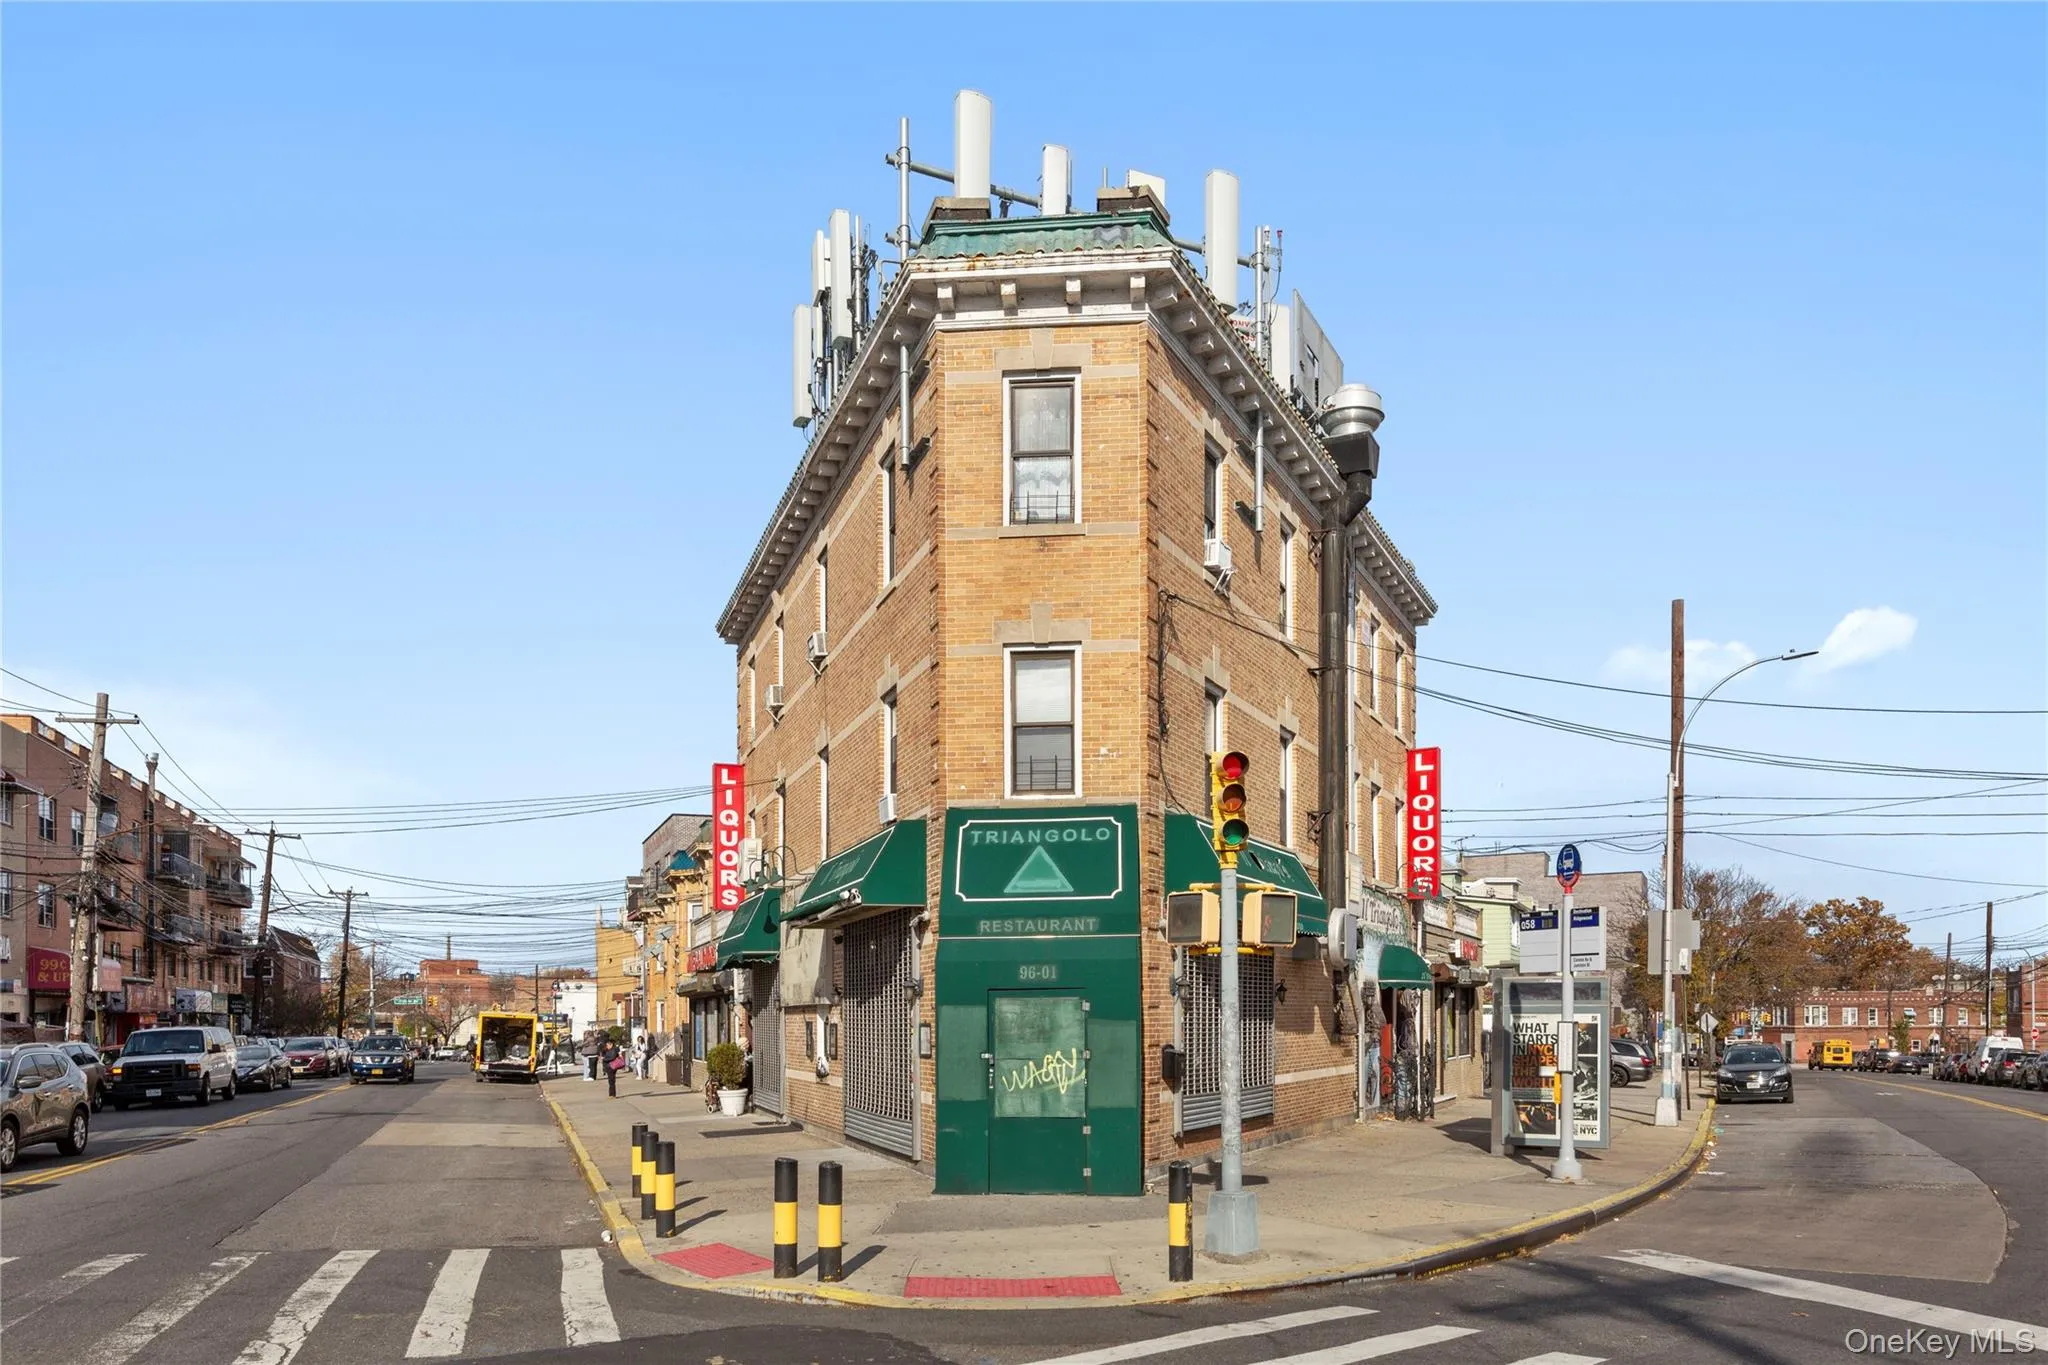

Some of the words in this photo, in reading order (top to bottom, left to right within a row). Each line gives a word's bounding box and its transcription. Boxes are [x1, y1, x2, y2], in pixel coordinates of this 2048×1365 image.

[1412, 753, 1434, 893] LIQUORS
[719, 768, 740, 906] LIQUORS
[970, 827, 1111, 846] TRIANGOLO
[979, 918, 1098, 934] RESTAURANT
[37, 971, 49, 983] &
[53, 972, 70, 982] UP
[1019, 964, 1057, 980] 96-01
[1513, 1022, 1549, 1034] WHAT
[1513, 1033, 1558, 1045] STARTS
[1513, 1044, 1526, 1056] IN
[1527, 1044, 1553, 1056] NYC
[1513, 1066, 1536, 1077] THE
[1579, 1127, 1598, 1135] NYC
